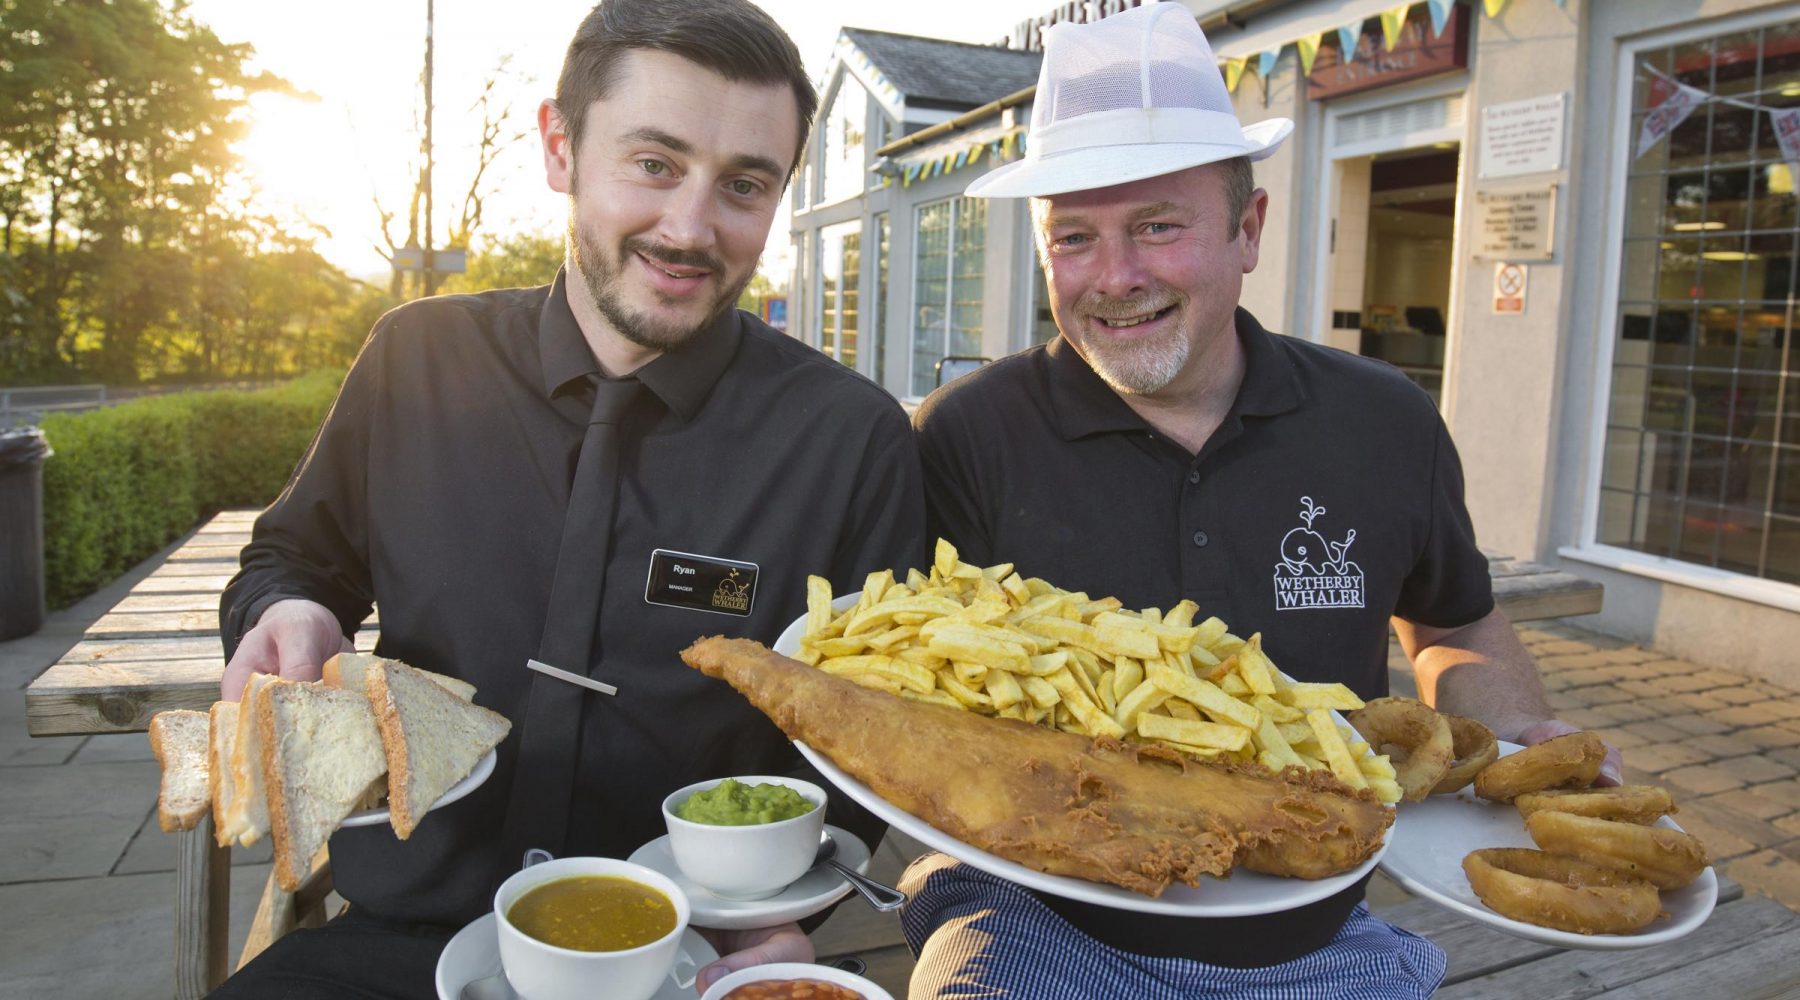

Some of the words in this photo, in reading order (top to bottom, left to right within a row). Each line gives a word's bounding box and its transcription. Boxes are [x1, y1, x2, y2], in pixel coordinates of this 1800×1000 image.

[673, 564, 696, 575] Ryan
[1276, 576, 1361, 590] WETHERBY
[1279, 590, 1362, 606] WHALER
[714, 600, 746, 609] WHALER
